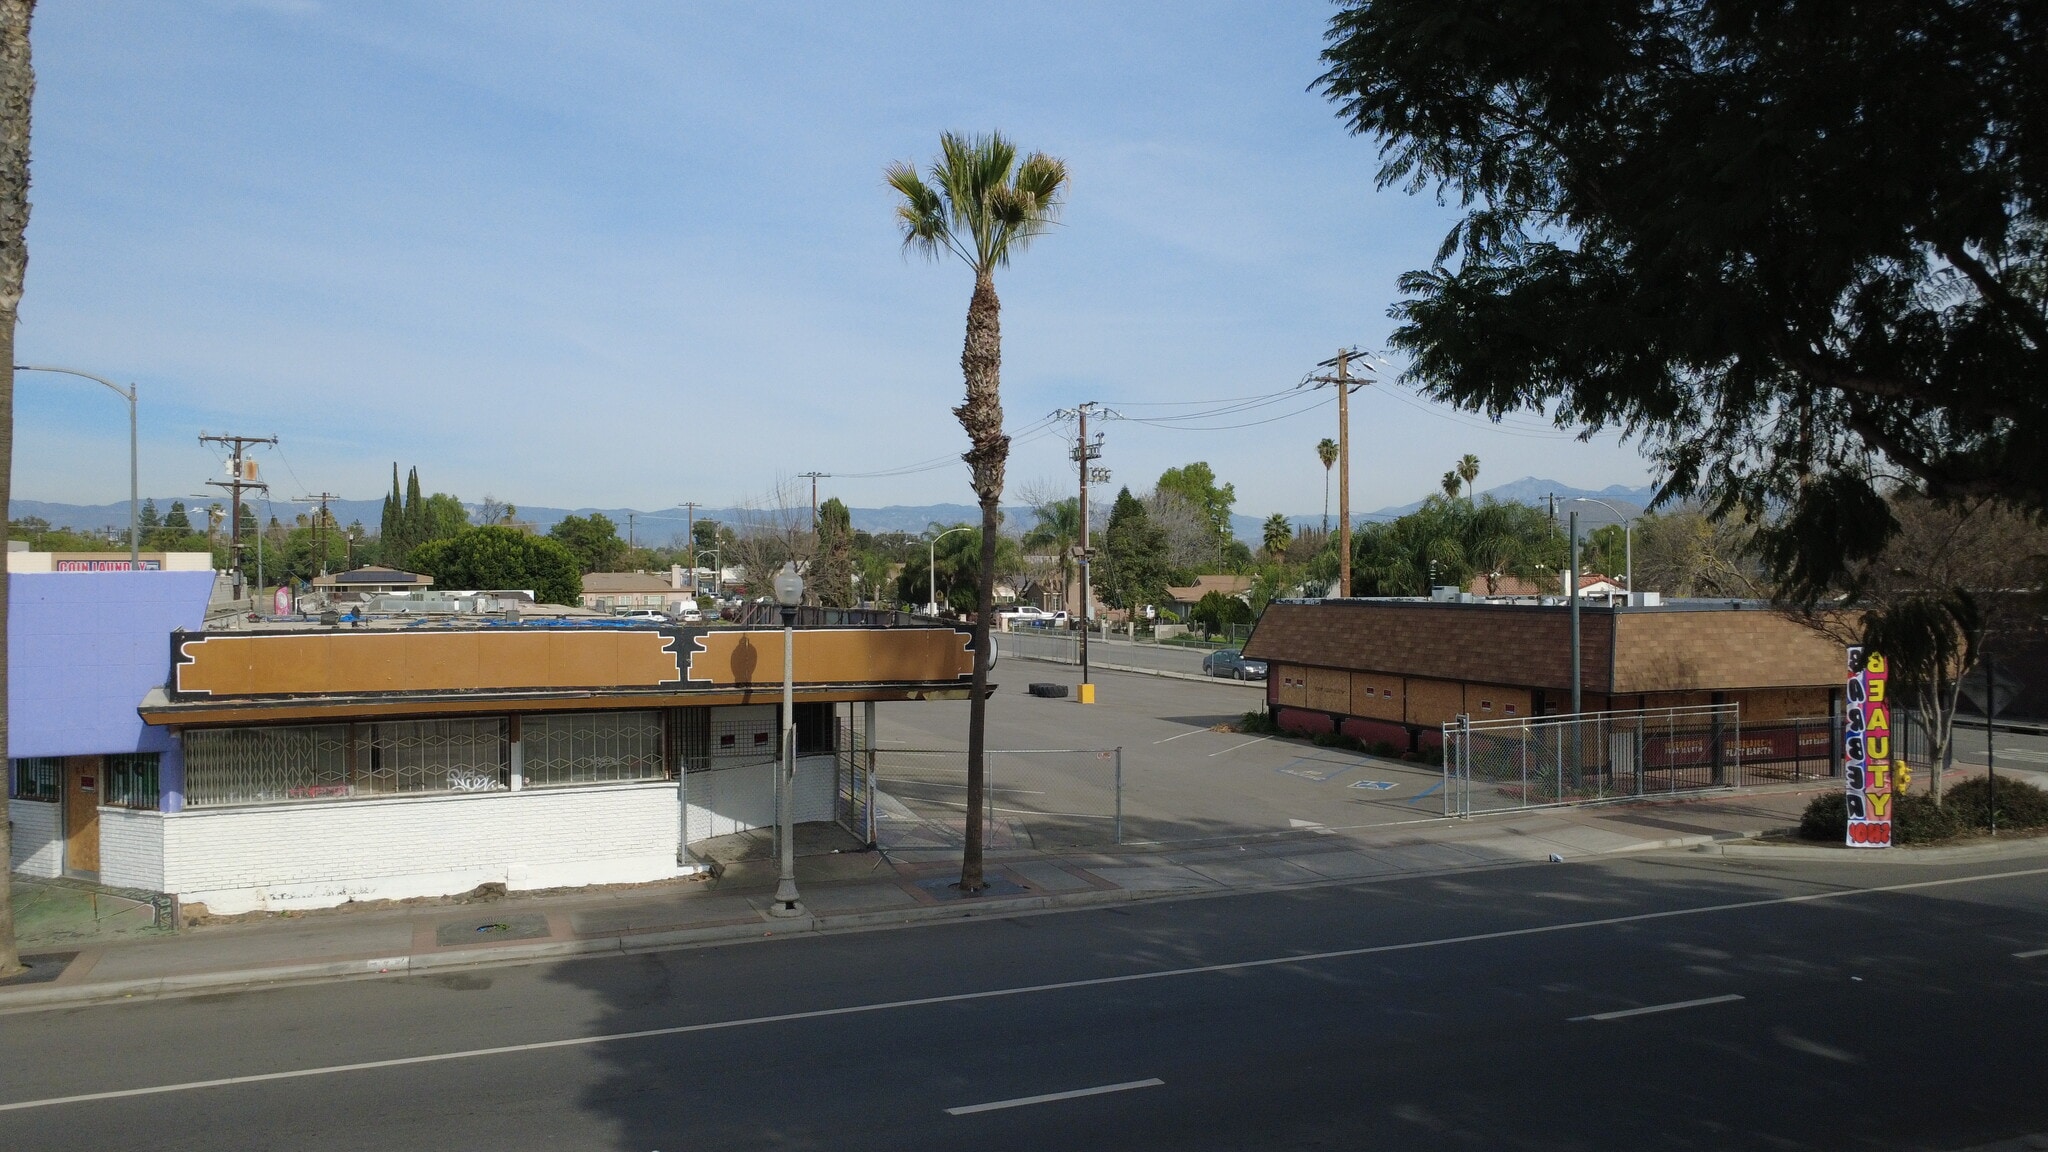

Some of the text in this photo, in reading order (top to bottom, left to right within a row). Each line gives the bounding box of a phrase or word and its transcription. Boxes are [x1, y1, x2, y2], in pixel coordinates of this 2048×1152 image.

[58, 561, 147, 572] COIN LAUNDY
[1725, 746, 1774, 757] FLAT EARTH
